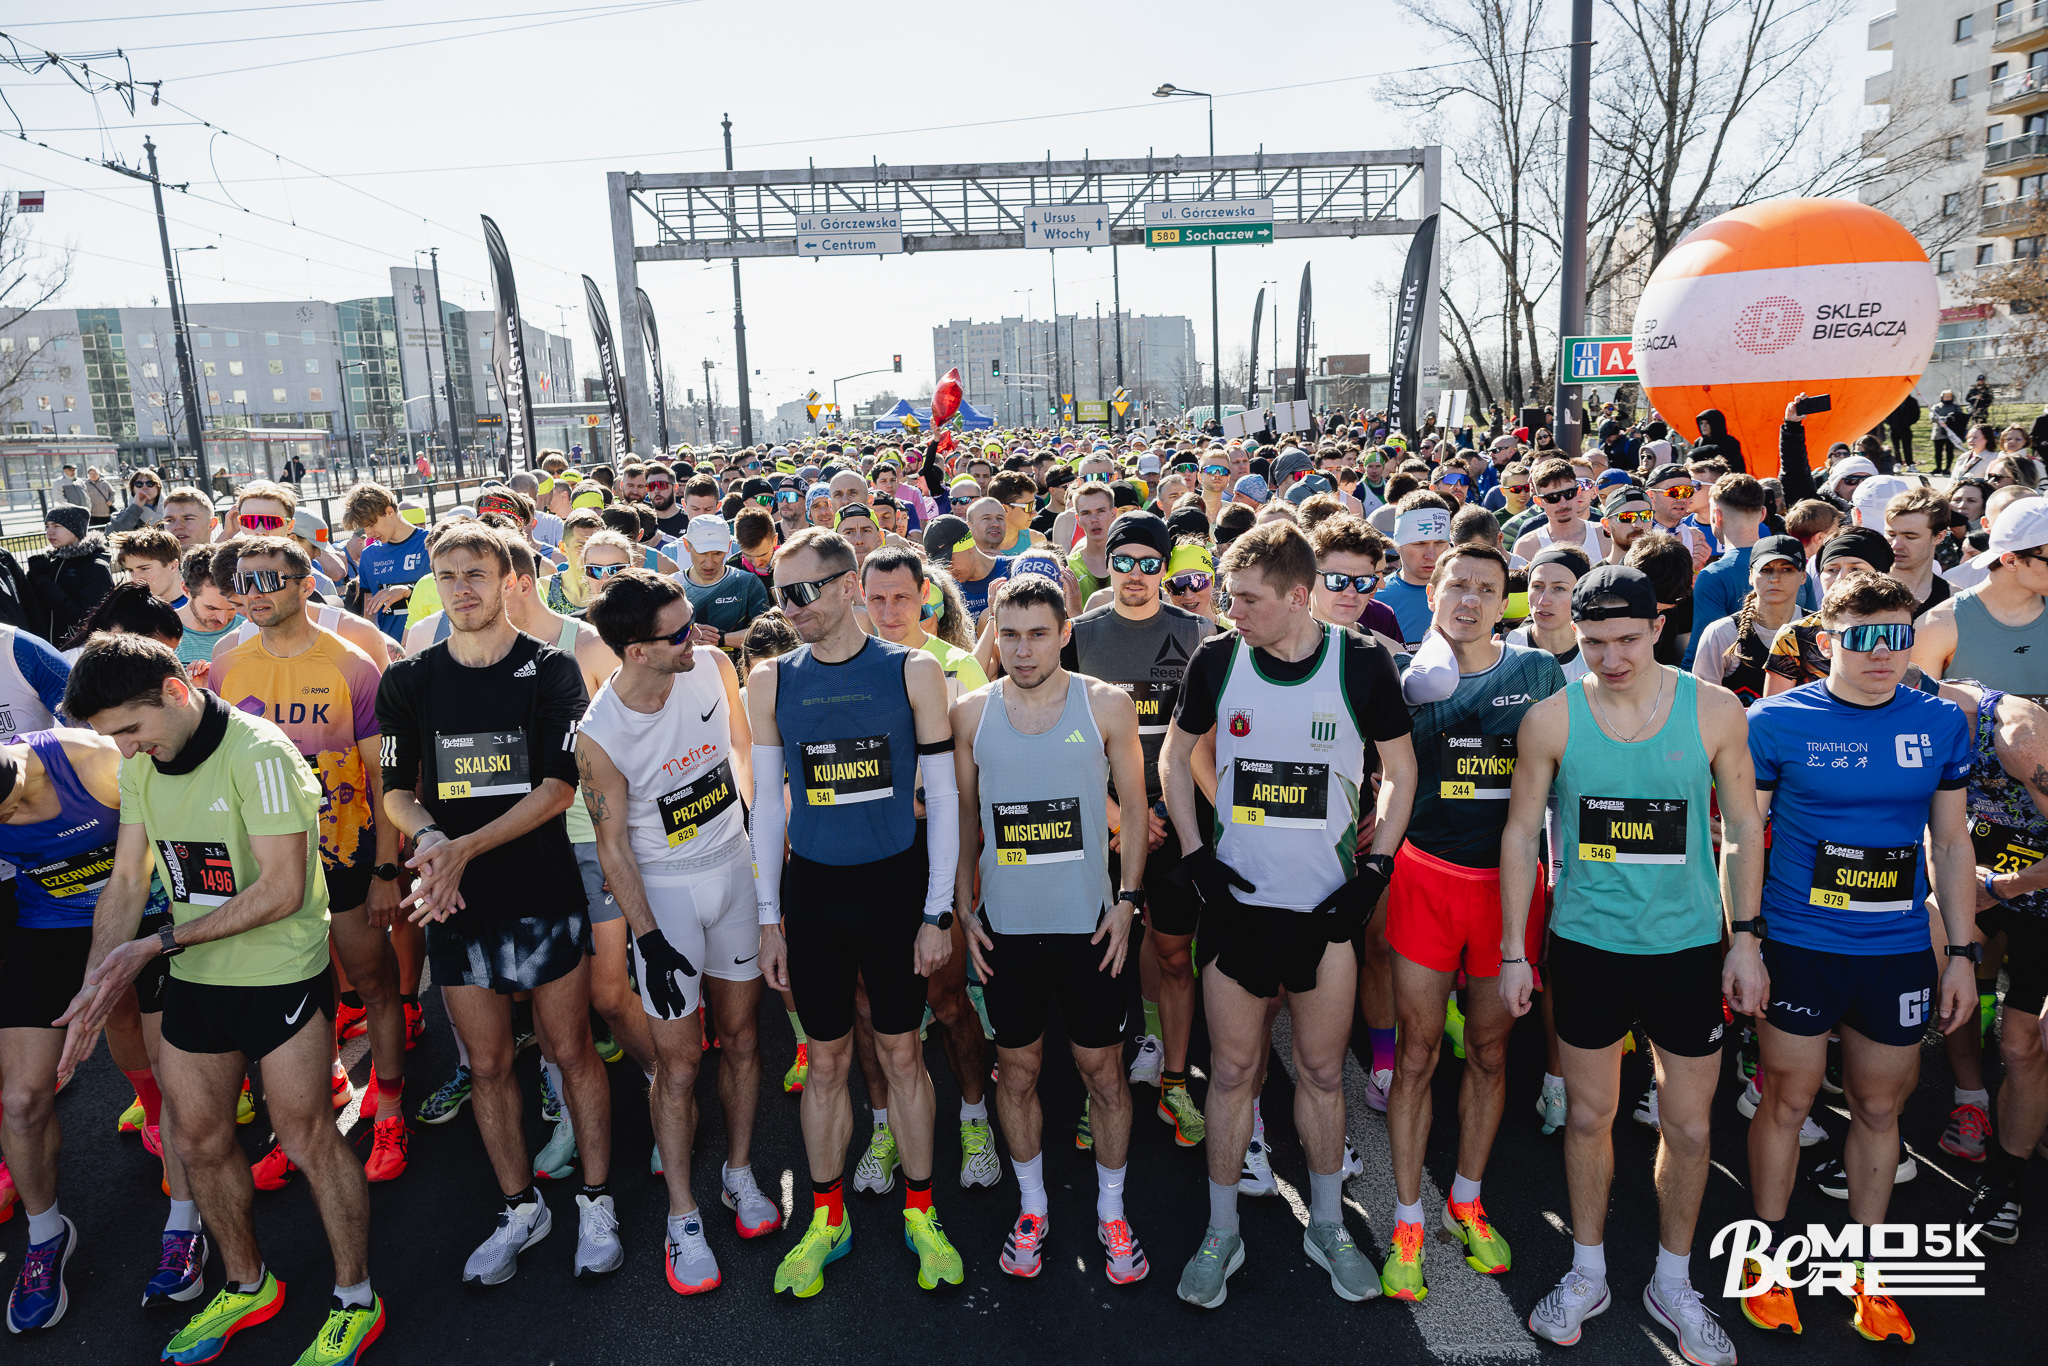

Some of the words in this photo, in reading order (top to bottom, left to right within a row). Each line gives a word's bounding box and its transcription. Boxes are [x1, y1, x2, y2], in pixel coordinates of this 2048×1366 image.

[1043, 212, 1076, 223] Ursus
[1161, 210, 1176, 220] ul.
[1181, 206, 1255, 219] Górczewska
[801, 219, 816, 231] ul.
[820, 217, 897, 230] Górczewska
[1044, 228, 1091, 241] Włochy
[1157, 231, 1176, 242] 580
[1185, 229, 1255, 242] Sochaczew
[822, 239, 876, 251] Centrum
[1816, 302, 1882, 320] SKLEP
[1813, 320, 1907, 340] BIEGACZA
[2013, 645, 2031, 654] 4F
[802, 694, 872, 706] BRUBECK
[274, 703, 331, 724] LDK
[1132, 700, 1159, 715] RAN
[1806, 742, 1868, 752] TRIATHLON
[455, 754, 511, 775] SKALSKI
[814, 759, 880, 782] KUJAWSKI
[1457, 755, 1518, 775] GIŻYŃSK
[450, 785, 466, 796] 914
[817, 792, 831, 803] 541
[1252, 783, 1308, 804] ARENDT
[1452, 785, 1470, 796] 244
[673, 782, 729, 825] PRZYBYŁA
[1247, 810, 1257, 822] 15
[57, 818, 100, 838] KIPRUN
[678, 827, 695, 842] 829
[1003, 821, 1073, 842] MISIEWICZ
[1611, 821, 1654, 840] KUNA
[1007, 851, 1023, 862] 672
[1591, 847, 1611, 859] 546
[200, 869, 234, 893] 1496
[1835, 868, 1899, 889] SUCHAN
[62, 884, 82, 896] 145
[1823, 893, 1844, 907] 979
